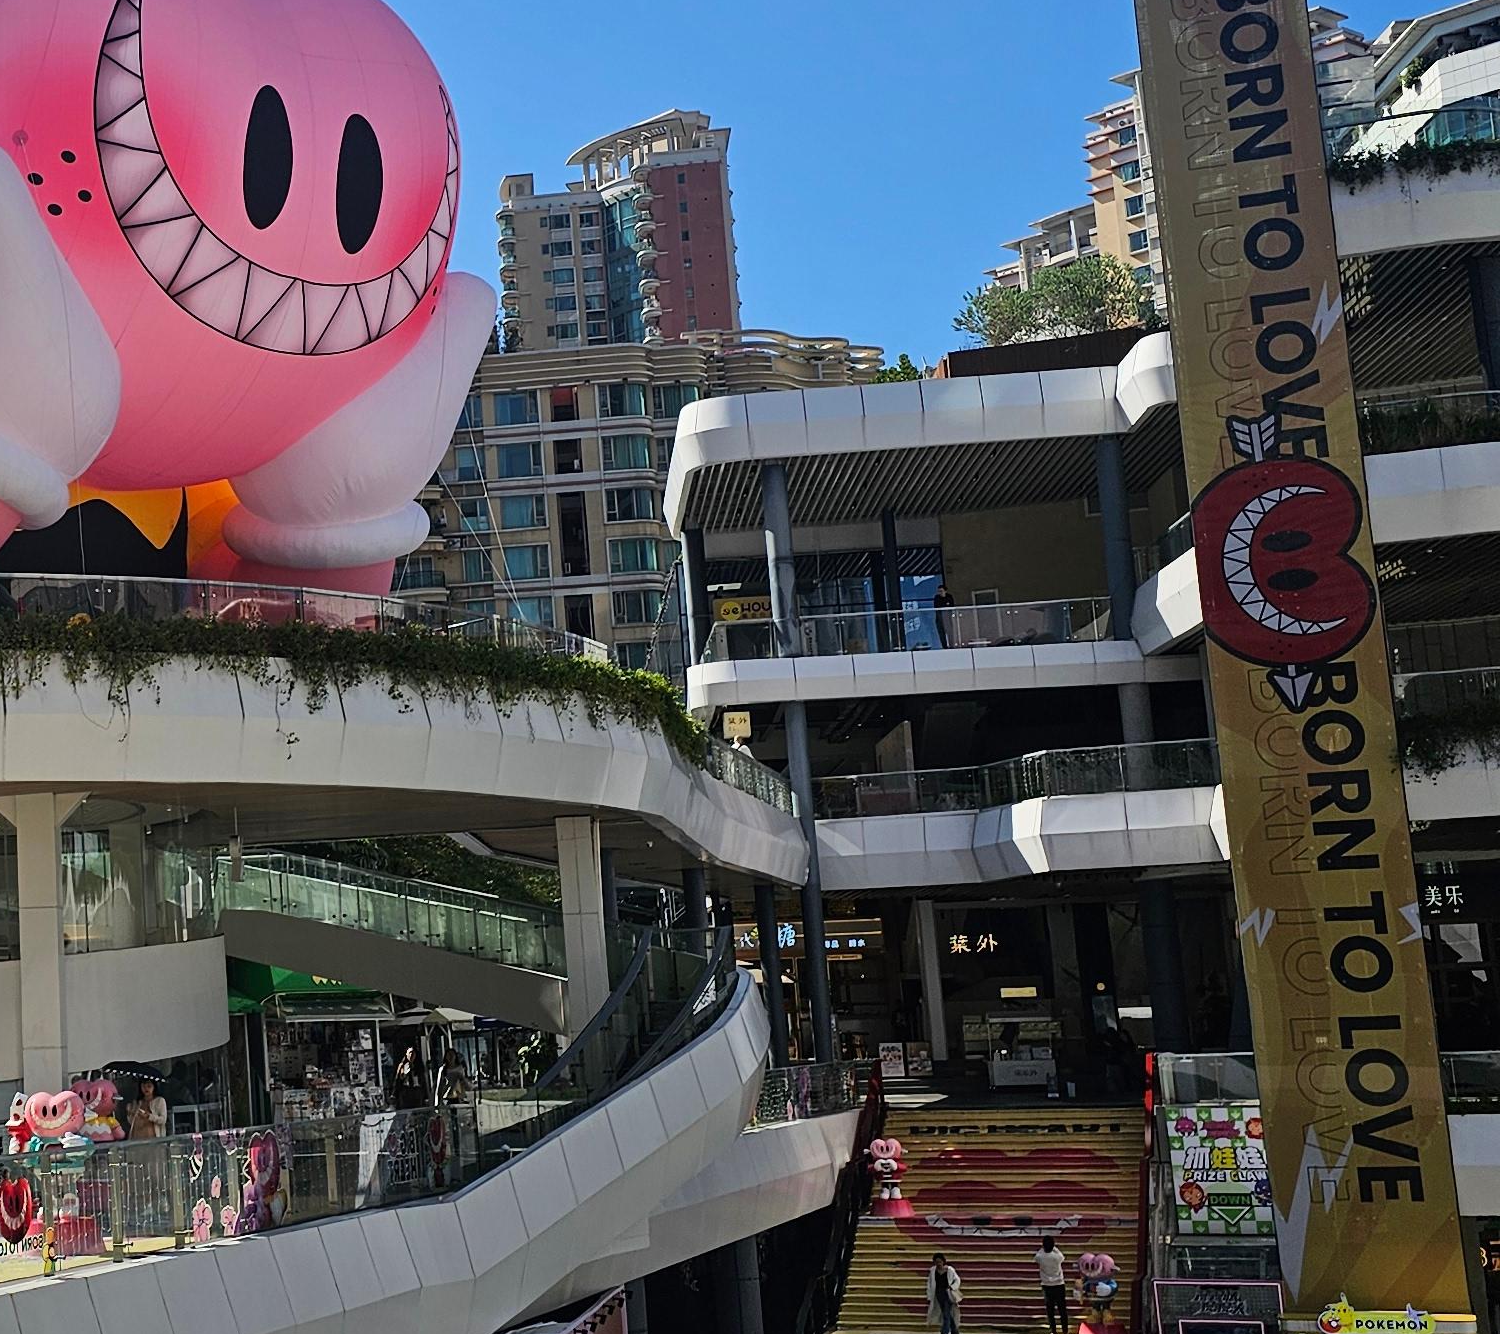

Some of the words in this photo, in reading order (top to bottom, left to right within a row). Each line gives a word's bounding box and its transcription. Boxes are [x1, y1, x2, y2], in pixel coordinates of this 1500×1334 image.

[1239, 174, 1305, 271] TO
[1250, 287, 1330, 460] LOVE
[1300, 661, 1380, 871] BORN
[1424, 885, 1464, 907] 美乐
[1323, 891, 1394, 993] TO
[1338, 1015, 1425, 1203] LOVE
[1183, 1171, 1227, 1182] PRIZE
[1184, 1146, 1268, 1169] 抓娃娃
[1209, 1195, 1251, 1205] DOWN
[1355, 1319, 1428, 1330] POKEMON
